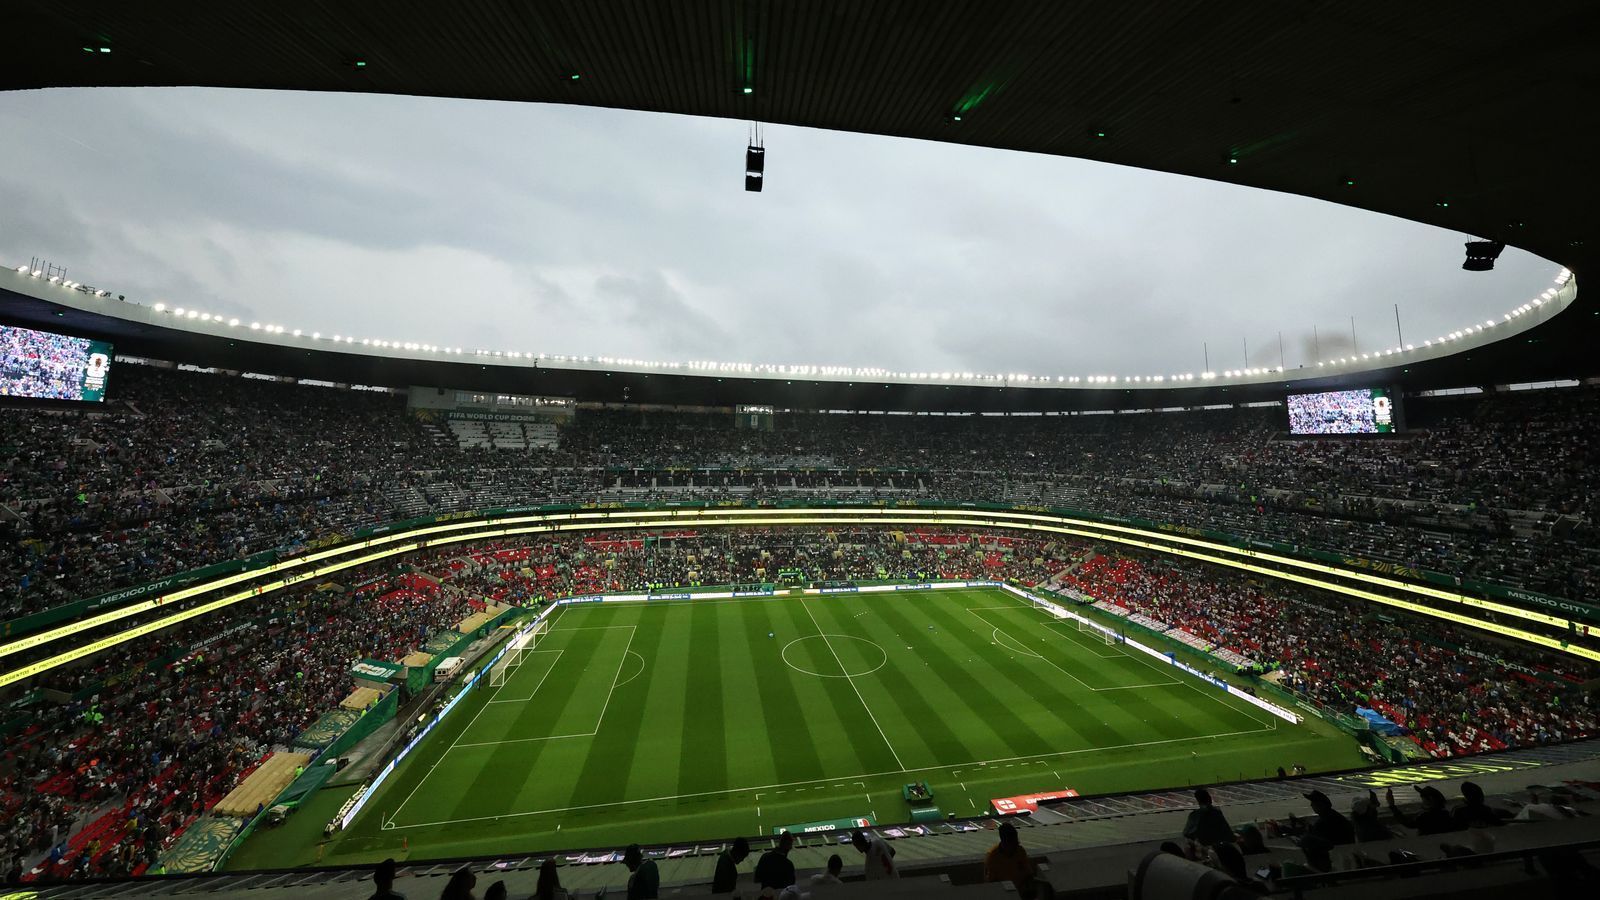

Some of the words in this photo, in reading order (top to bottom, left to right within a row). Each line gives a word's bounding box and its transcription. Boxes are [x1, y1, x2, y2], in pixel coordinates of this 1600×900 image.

[466, 412, 493, 420] WORLD
[495, 413, 510, 421] CUP
[100, 586, 146, 605] MEXICO
[147, 579, 172, 591] CITY
[1507, 590, 1558, 607] MEXICO
[1559, 602, 1590, 615] CITY
[190, 641, 203, 652] FIFA
[203, 633, 224, 645] WORLD
[223, 628, 235, 637] CUP
[804, 824, 836, 833] MEXICO
